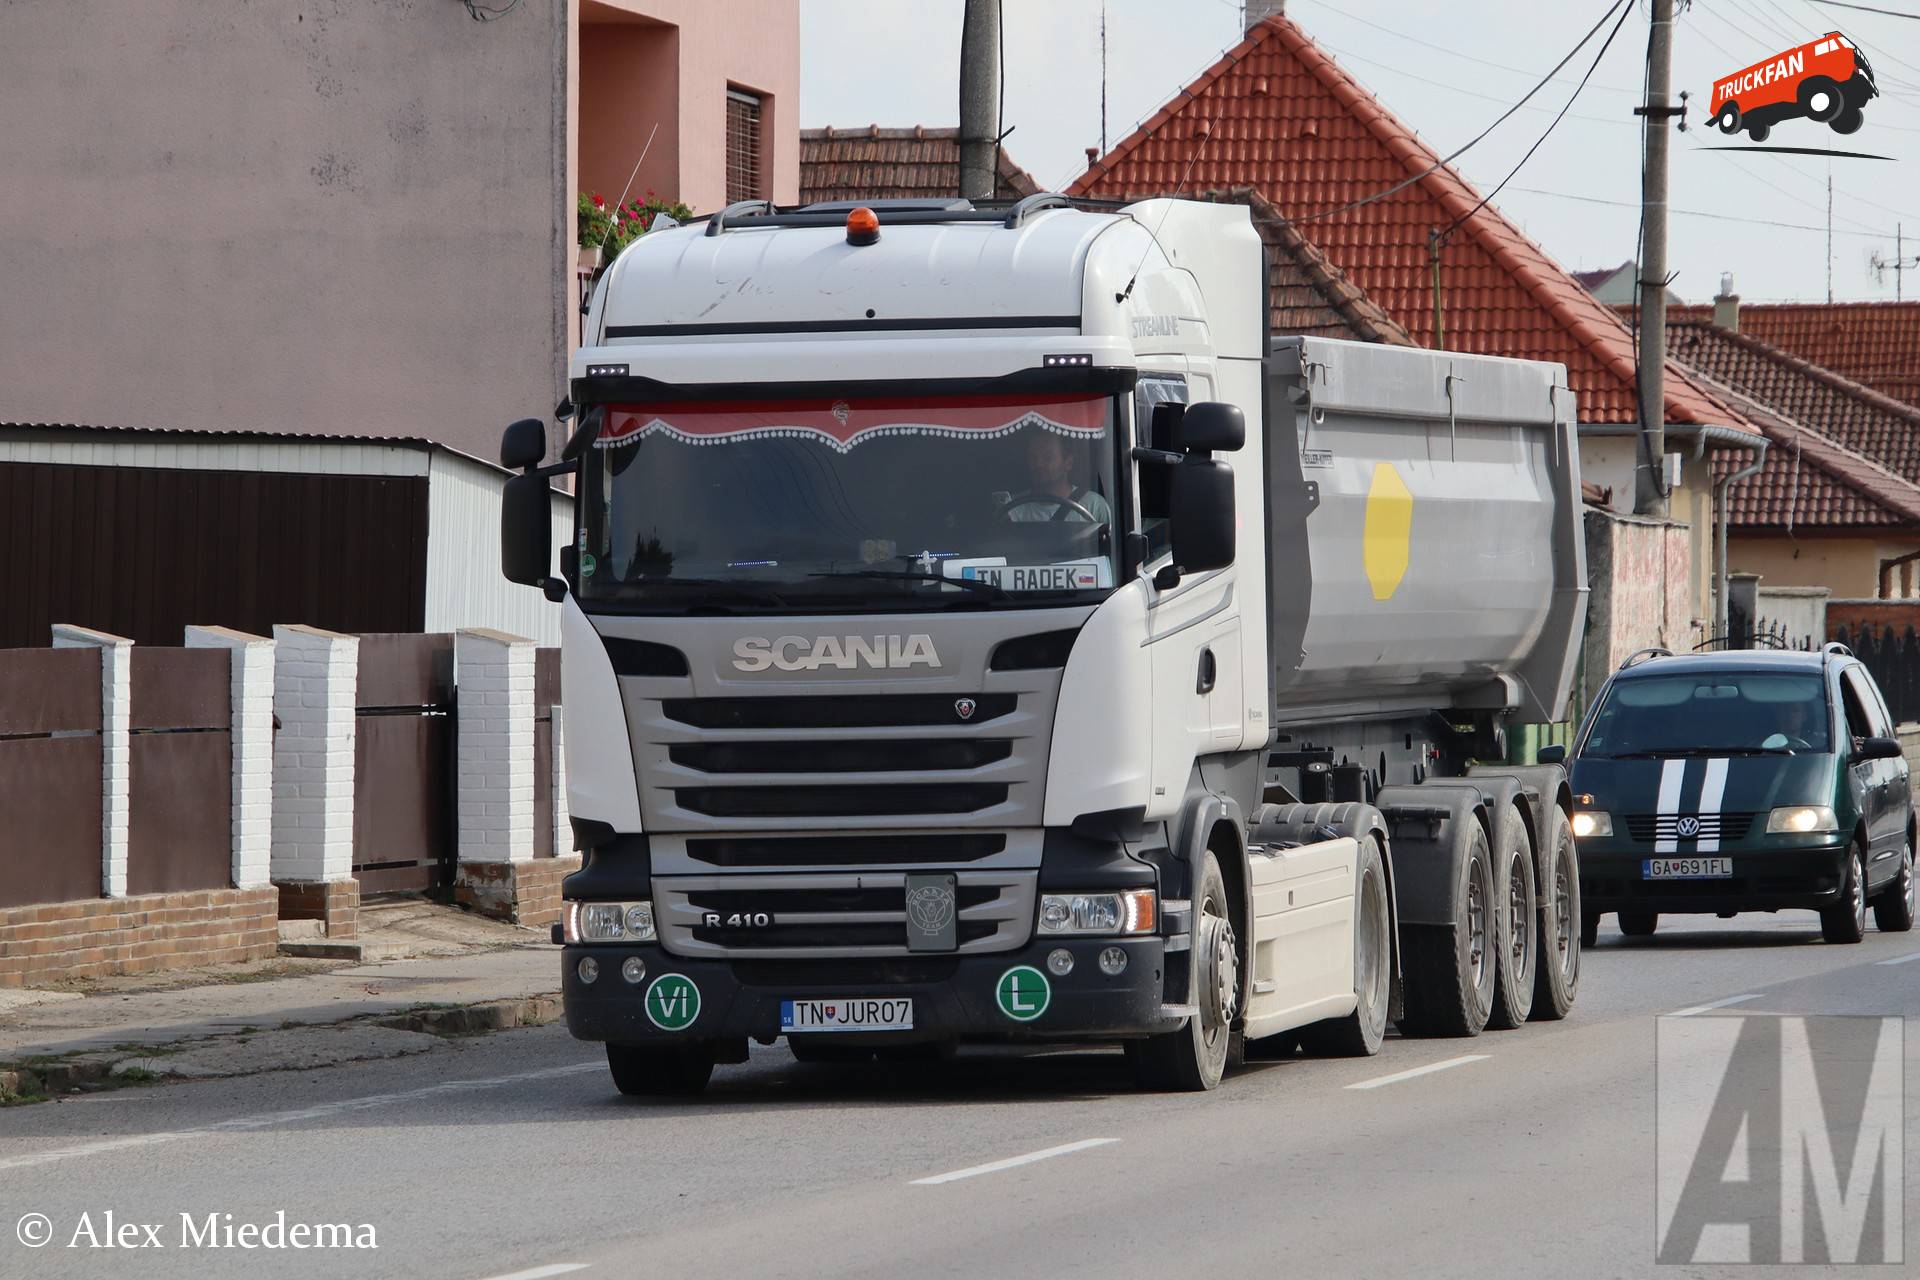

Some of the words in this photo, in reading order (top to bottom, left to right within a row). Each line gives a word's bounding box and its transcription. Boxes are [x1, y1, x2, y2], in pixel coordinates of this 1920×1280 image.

[1013, 568, 1078, 589] RADEK
[731, 633, 942, 672] SCANIA
[1652, 860, 1672, 875] GA
[1680, 859, 1730, 874] 691FL
[706, 914, 721, 927] R
[726, 913, 769, 927] 410
[656, 986, 688, 1018] VI
[1011, 975, 1035, 1011] L
[796, 1002, 824, 1024] TN
